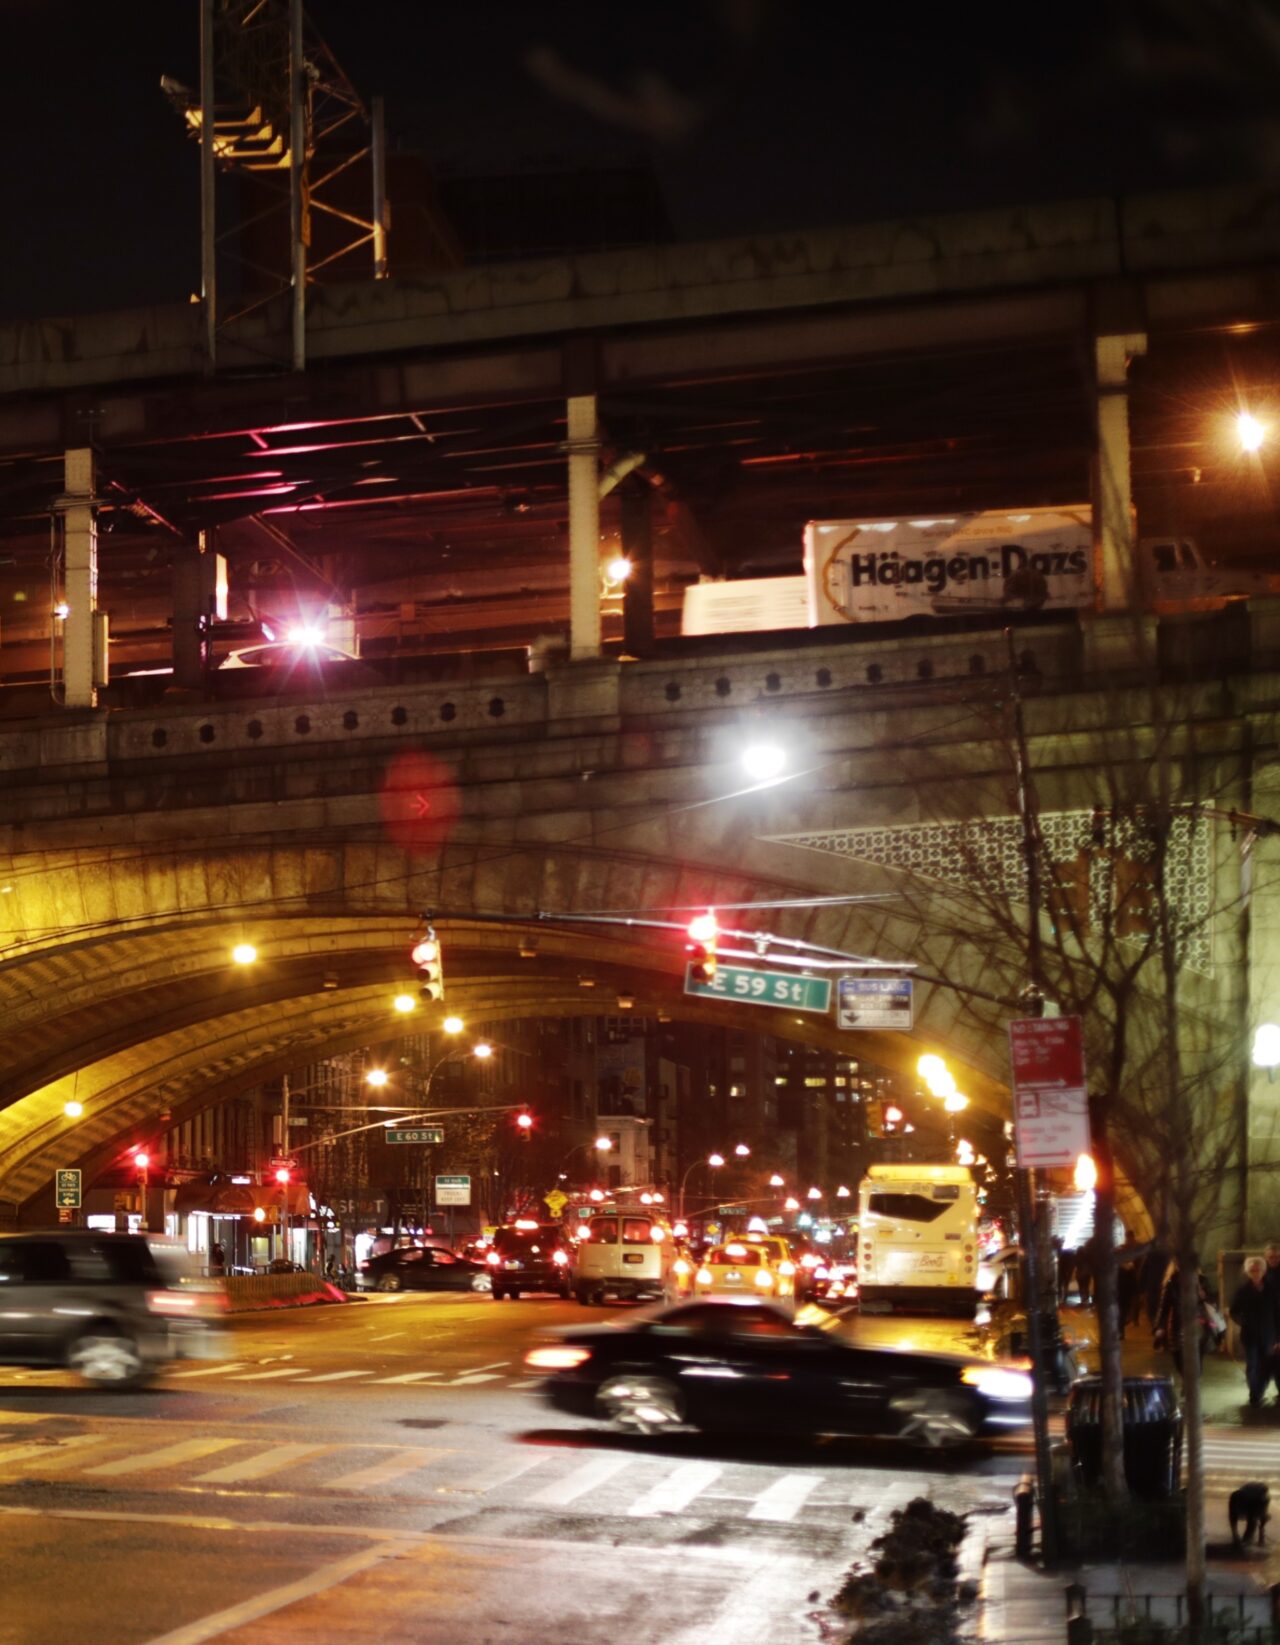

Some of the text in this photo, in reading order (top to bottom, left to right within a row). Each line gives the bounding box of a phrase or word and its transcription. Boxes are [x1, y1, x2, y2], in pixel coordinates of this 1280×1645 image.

[712, 973, 803, 1002] E 59 St
